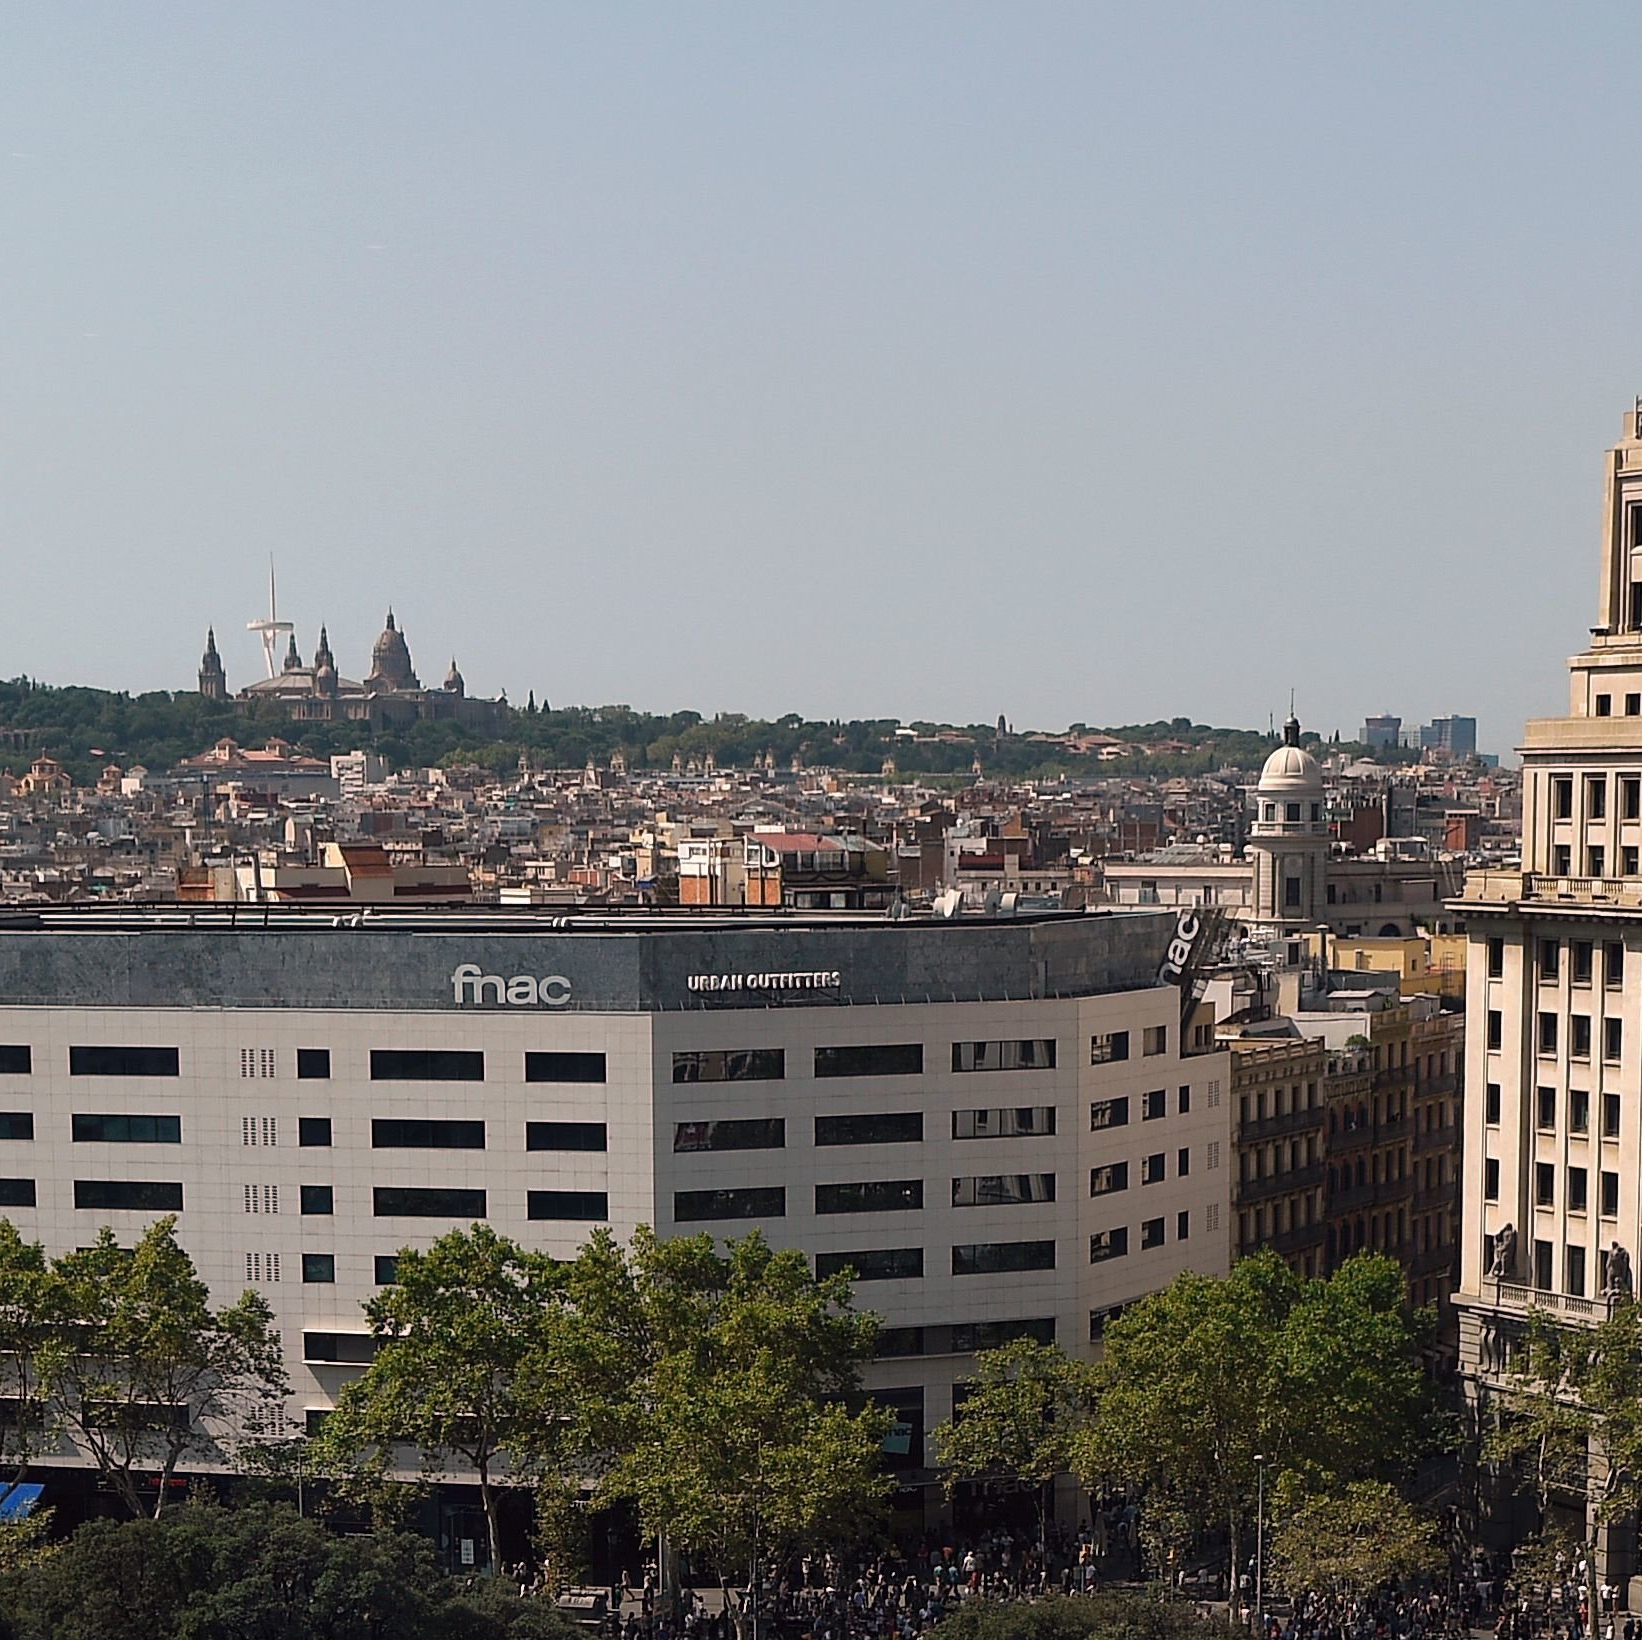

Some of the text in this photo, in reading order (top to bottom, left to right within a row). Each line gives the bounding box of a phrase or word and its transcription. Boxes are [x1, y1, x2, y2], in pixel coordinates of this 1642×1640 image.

[1159, 910, 1199, 986] nac
[451, 963, 572, 1005] fnac
[687, 971, 841, 992] URBAN OUTFITTERS
